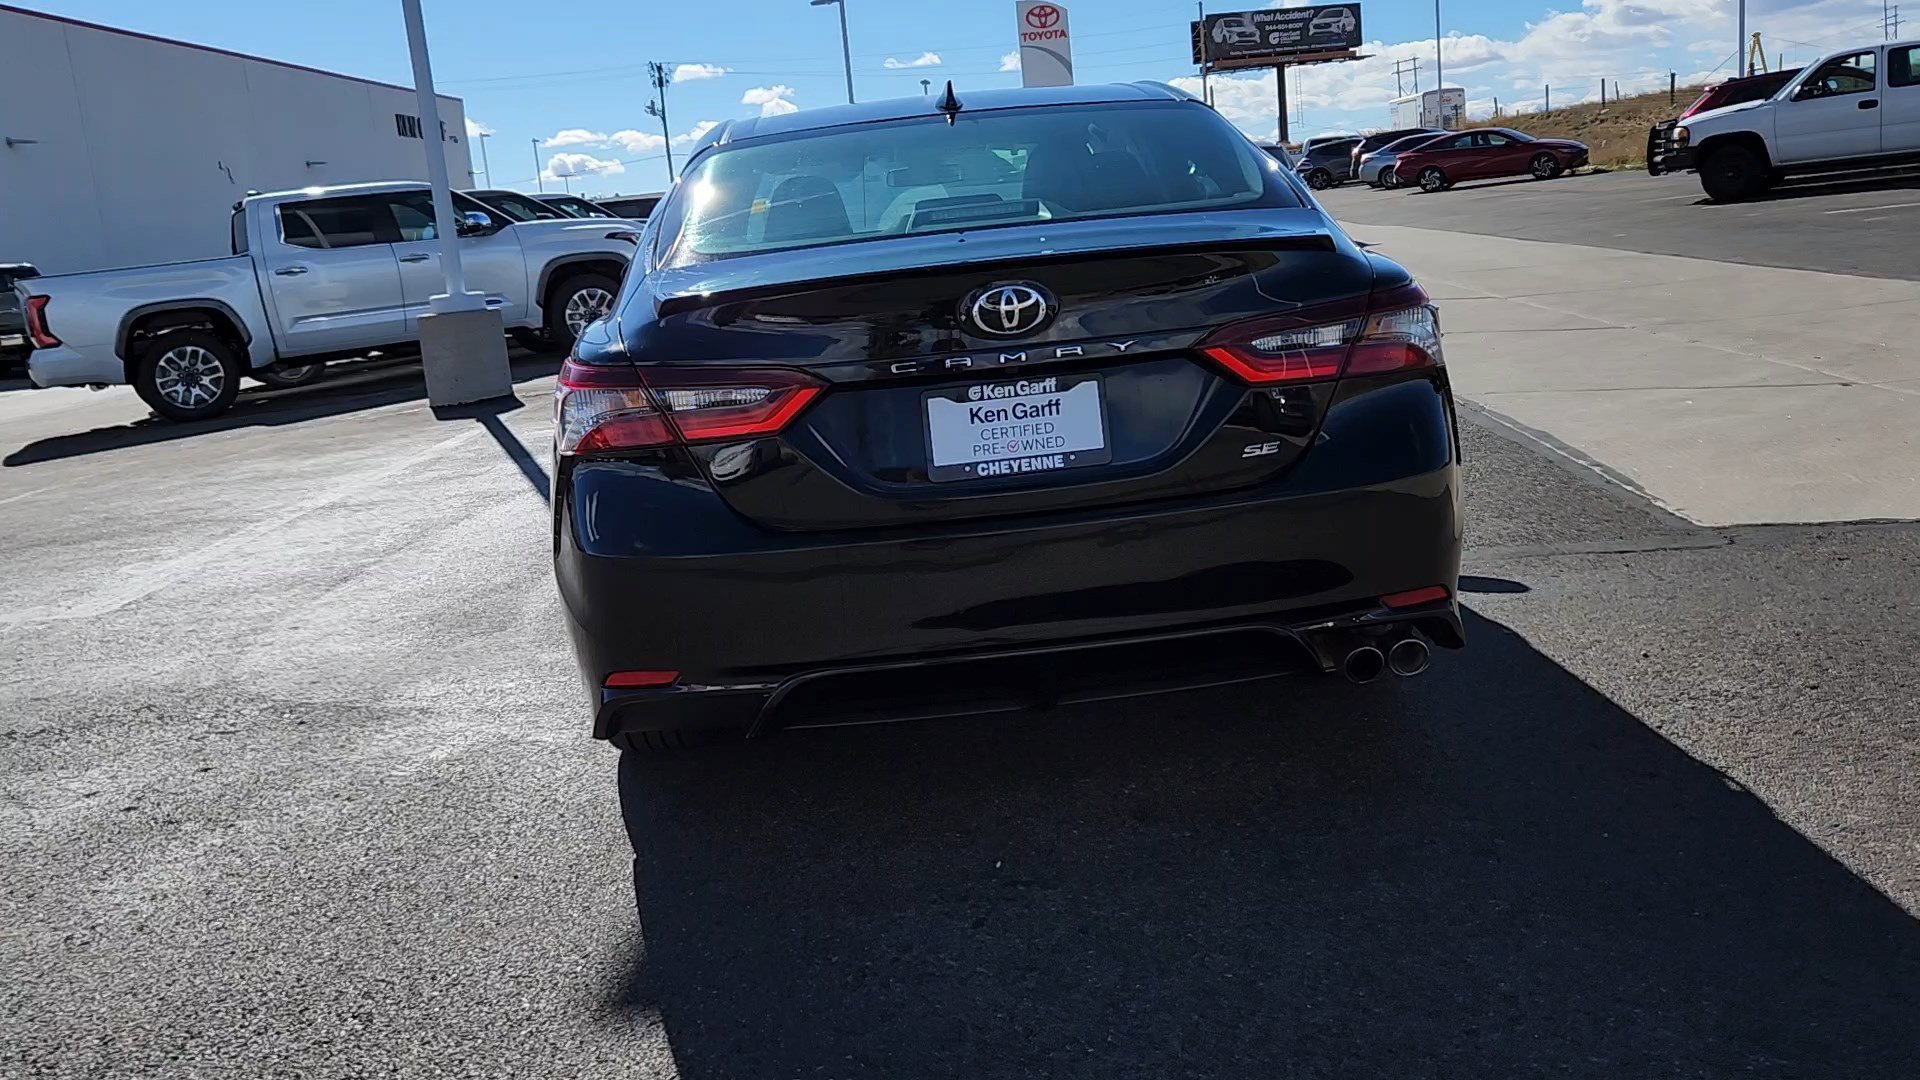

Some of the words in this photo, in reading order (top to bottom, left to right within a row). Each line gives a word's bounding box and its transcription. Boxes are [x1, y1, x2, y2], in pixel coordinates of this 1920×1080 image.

[1253, 13, 1274, 22] What
[1274, 10, 1314, 20] Accident?
[1021, 29, 1067, 42] TOYOTA
[890, 339, 1138, 374] CAMRY
[983, 384, 1015, 399] Ken
[1015, 377, 1057, 395] Garff
[969, 405, 1009, 425] Ken
[1012, 399, 1061, 419] Garff
[980, 422, 1055, 441] CERTIFIED
[973, 436, 1066, 456] PRE-OWNED
[1242, 441, 1280, 457] SE
[977, 455, 1065, 477] CHEYENNE
